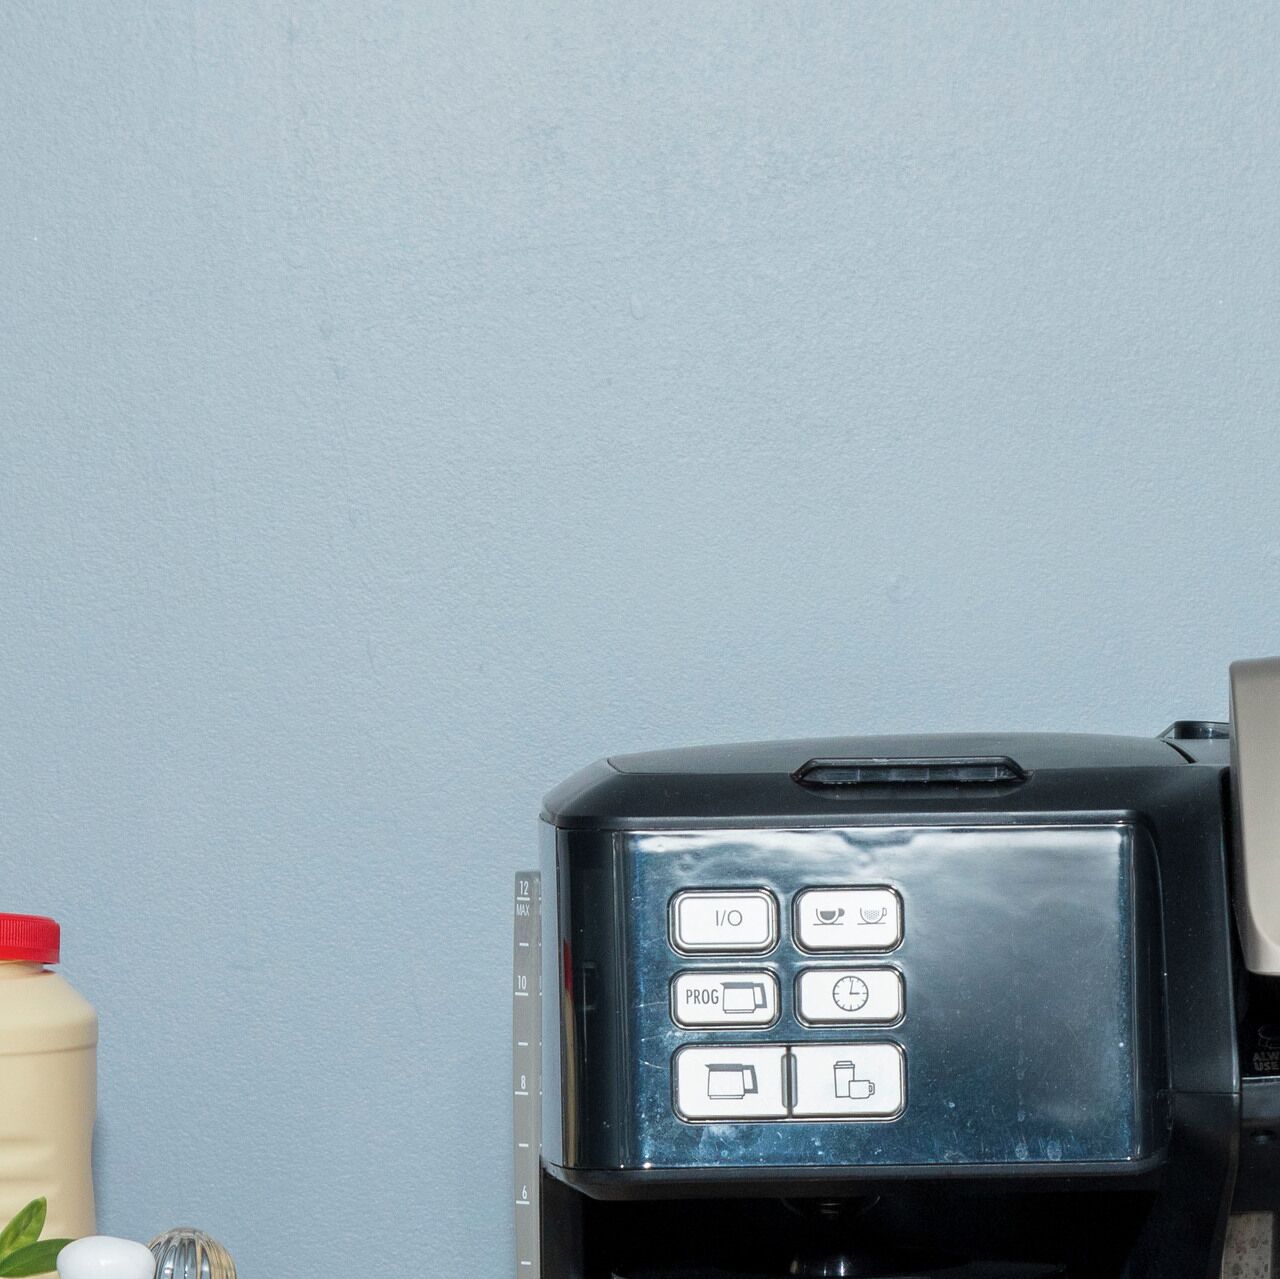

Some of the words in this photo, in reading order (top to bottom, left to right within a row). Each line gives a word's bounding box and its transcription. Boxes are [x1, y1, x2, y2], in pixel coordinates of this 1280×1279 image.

[519, 880, 529, 895] 12
[516, 903, 530, 917] MAX
[715, 909, 743, 927] I/O
[517, 975, 527, 990] 10
[685, 989, 719, 1005] PROG
[520, 1075, 527, 1090] 8
[522, 1185, 528, 1200] 6
